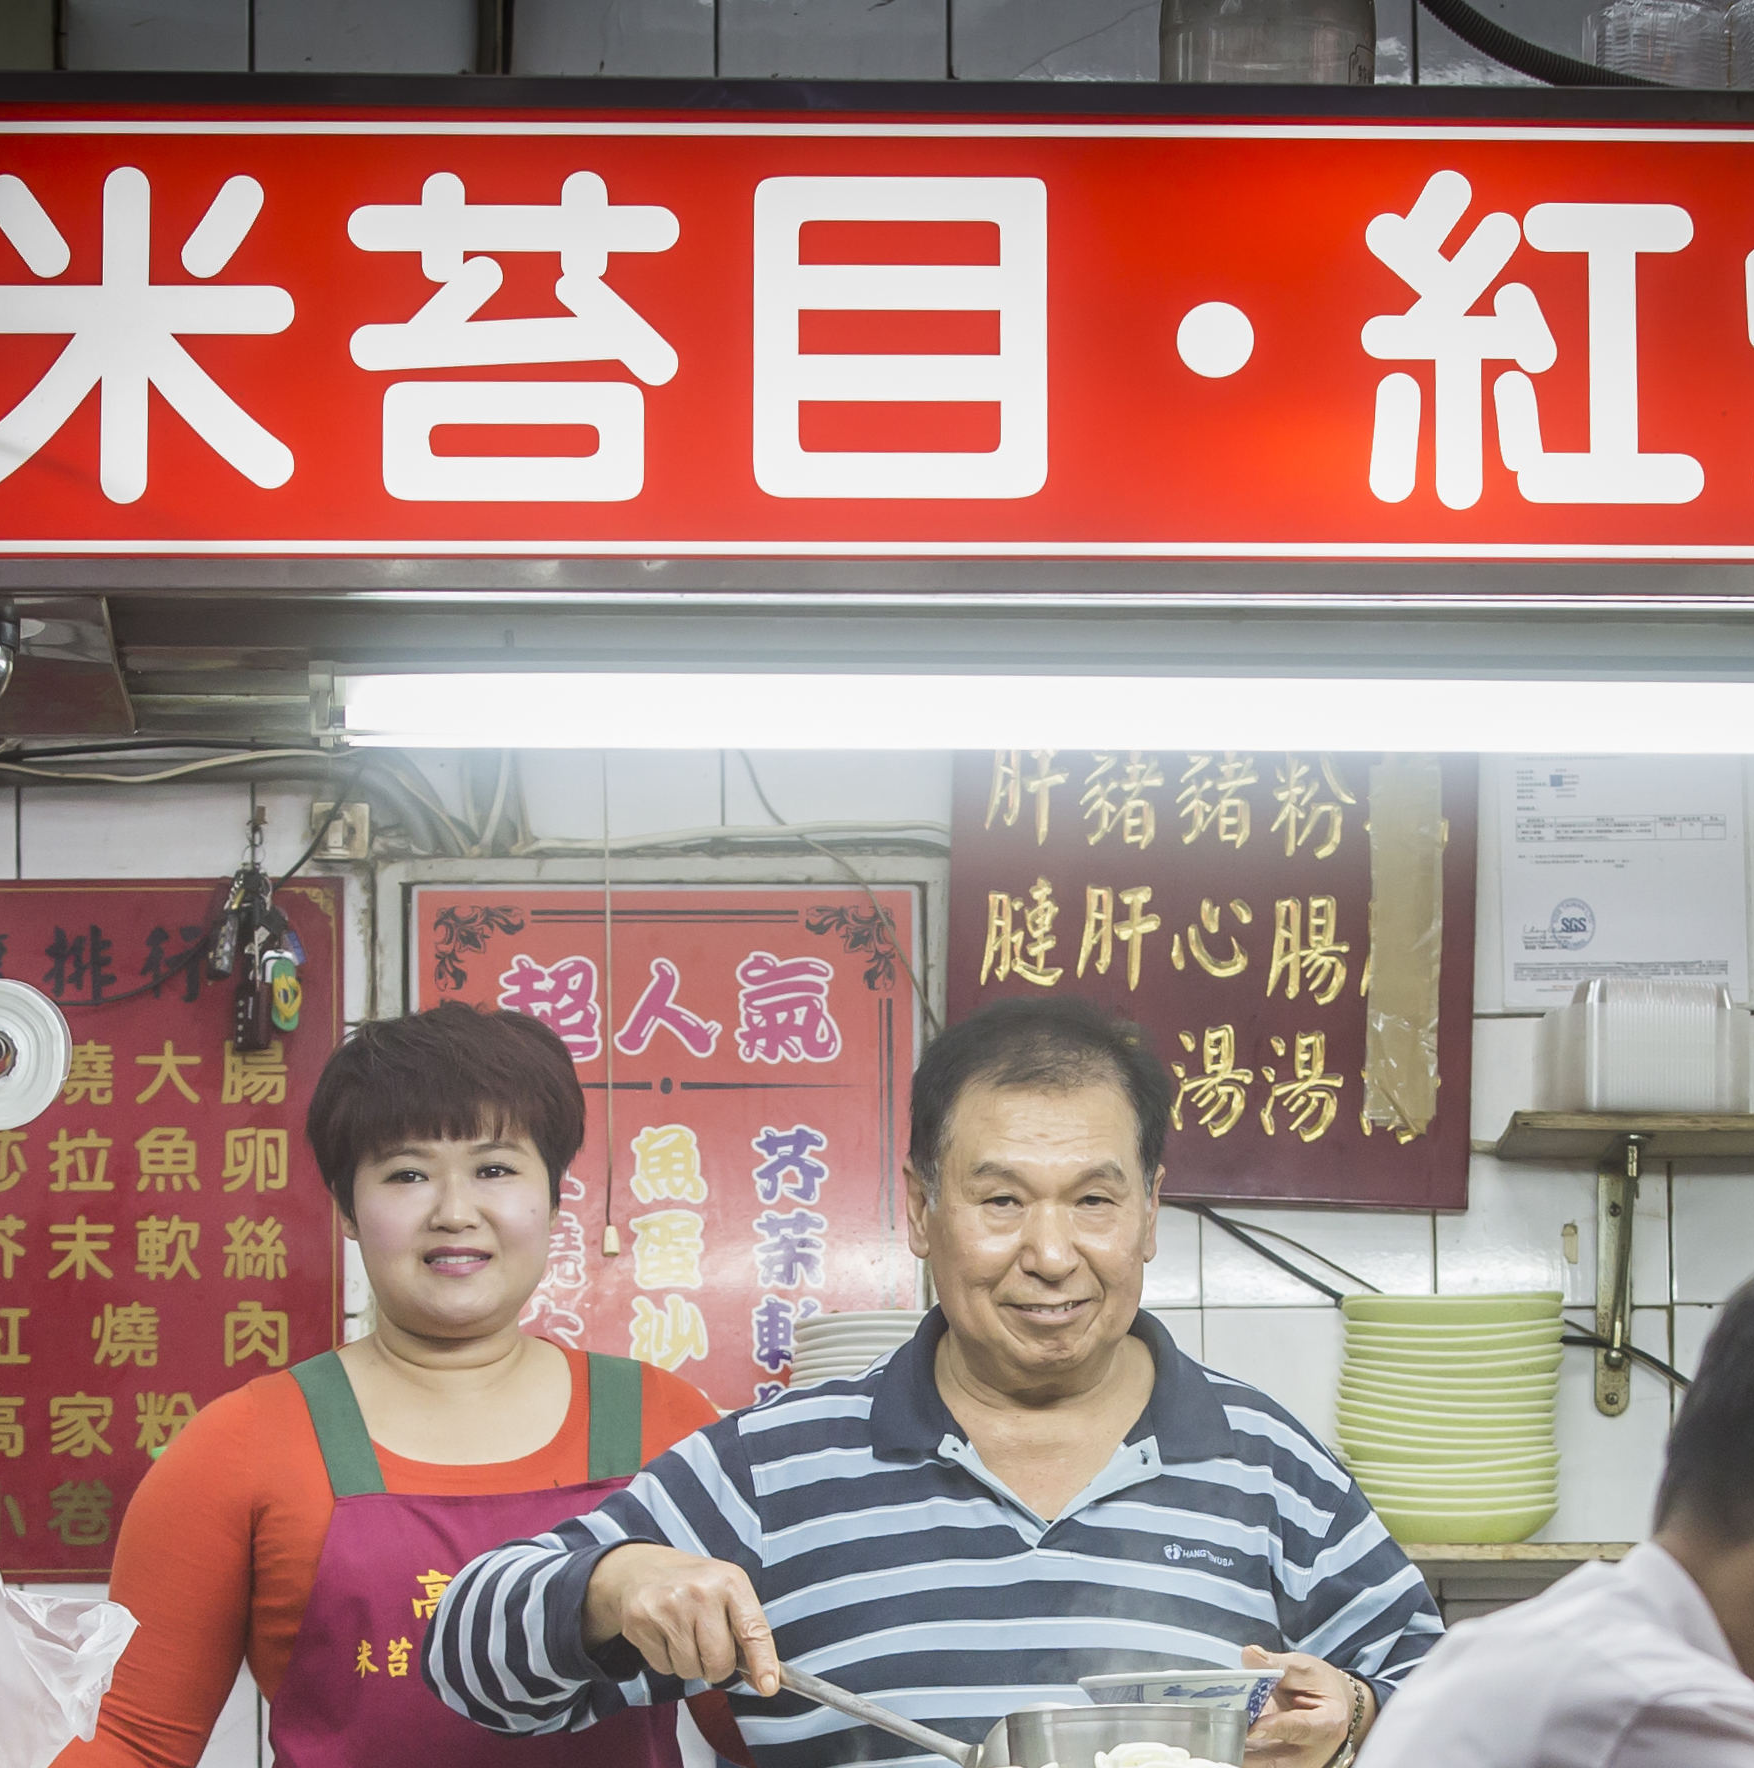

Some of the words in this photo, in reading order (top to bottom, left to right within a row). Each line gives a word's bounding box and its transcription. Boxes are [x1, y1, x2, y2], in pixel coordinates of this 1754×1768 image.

[1561, 917, 1587, 932] SGS
[497, 951, 842, 1064] 超人氣
